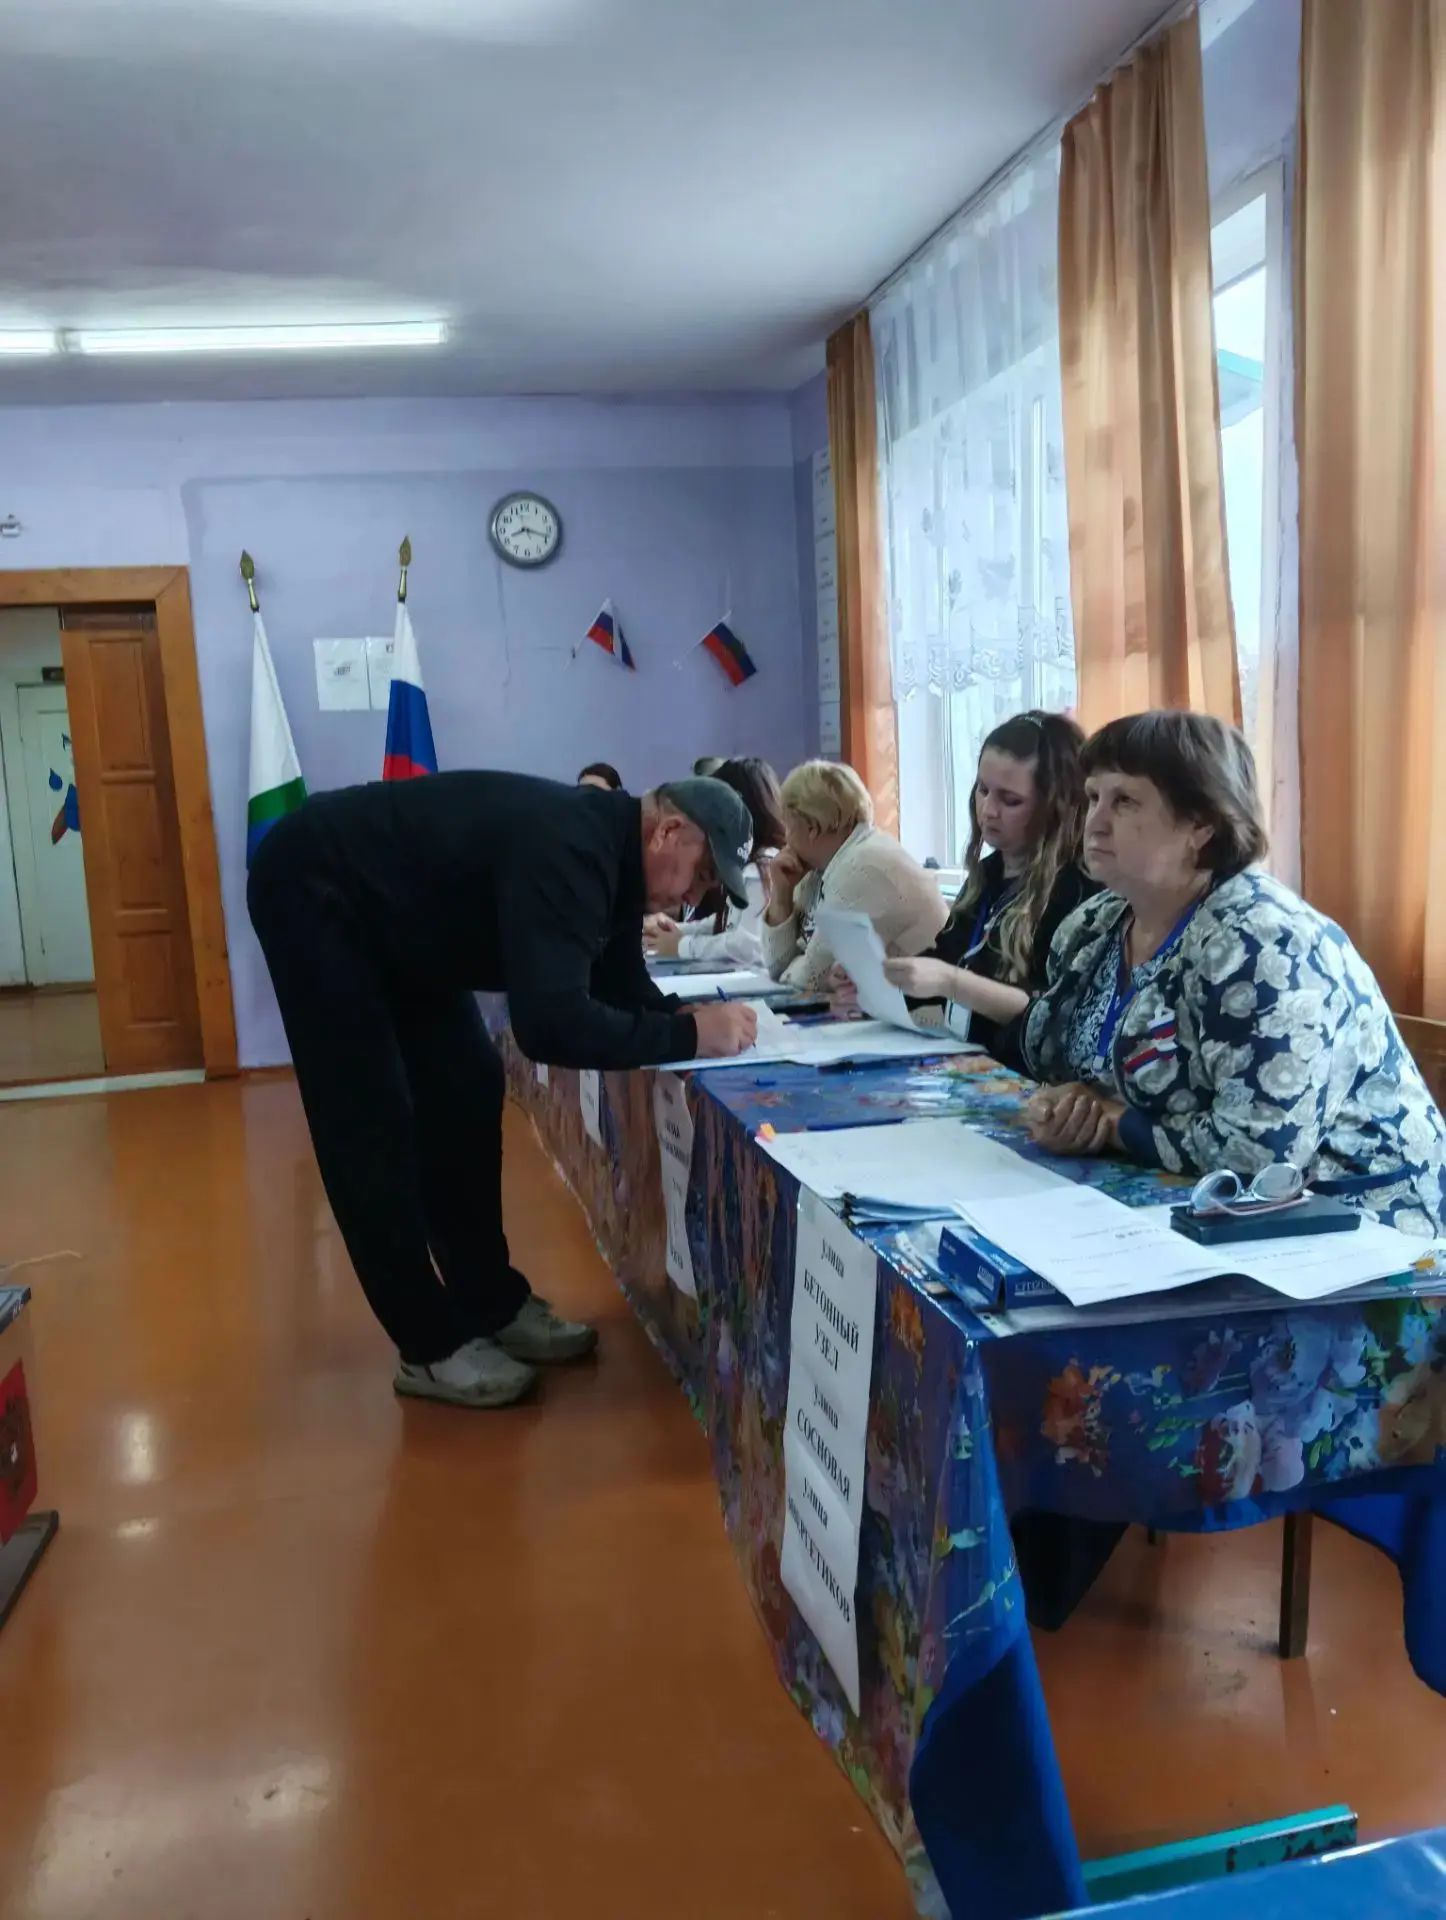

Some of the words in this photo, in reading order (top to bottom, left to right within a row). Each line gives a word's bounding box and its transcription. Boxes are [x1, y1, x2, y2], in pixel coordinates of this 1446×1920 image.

[821, 1238, 844, 1278] улица
[803, 1268, 859, 1354] БЕТОННЫЙ
[814, 1322, 840, 1373] УЗЕЛ
[812, 1382, 838, 1430] улица
[797, 1408, 850, 1504] СОСНОВАЯ
[803, 1476, 829, 1529] улица
[788, 1495, 851, 1624] РГЕТИКОВ
